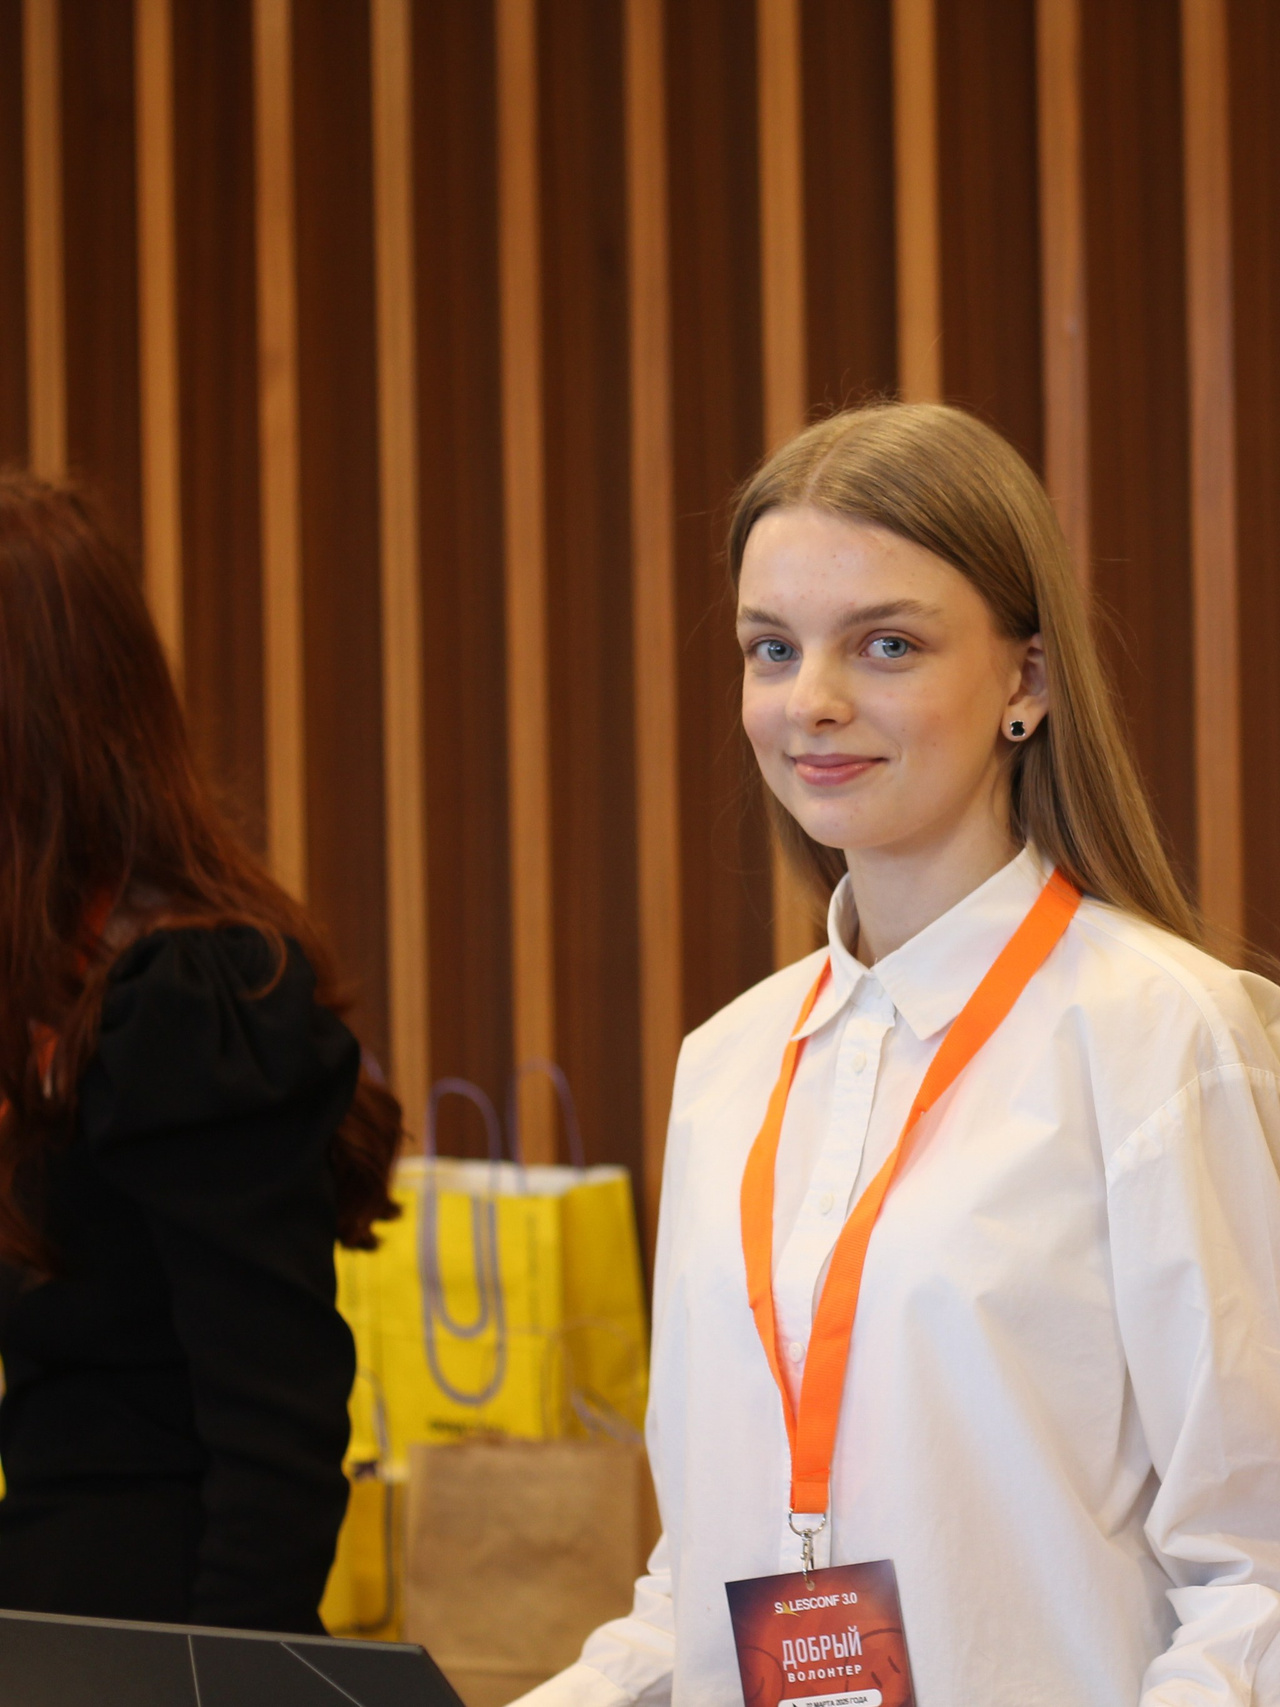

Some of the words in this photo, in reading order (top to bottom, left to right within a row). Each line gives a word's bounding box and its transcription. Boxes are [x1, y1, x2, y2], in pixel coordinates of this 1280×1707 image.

[841, 1592, 858, 1605] 3.0
[781, 1625, 863, 1671] ДОБРЫЙ
[787, 1664, 863, 1683] ВОЛОНТЕР
